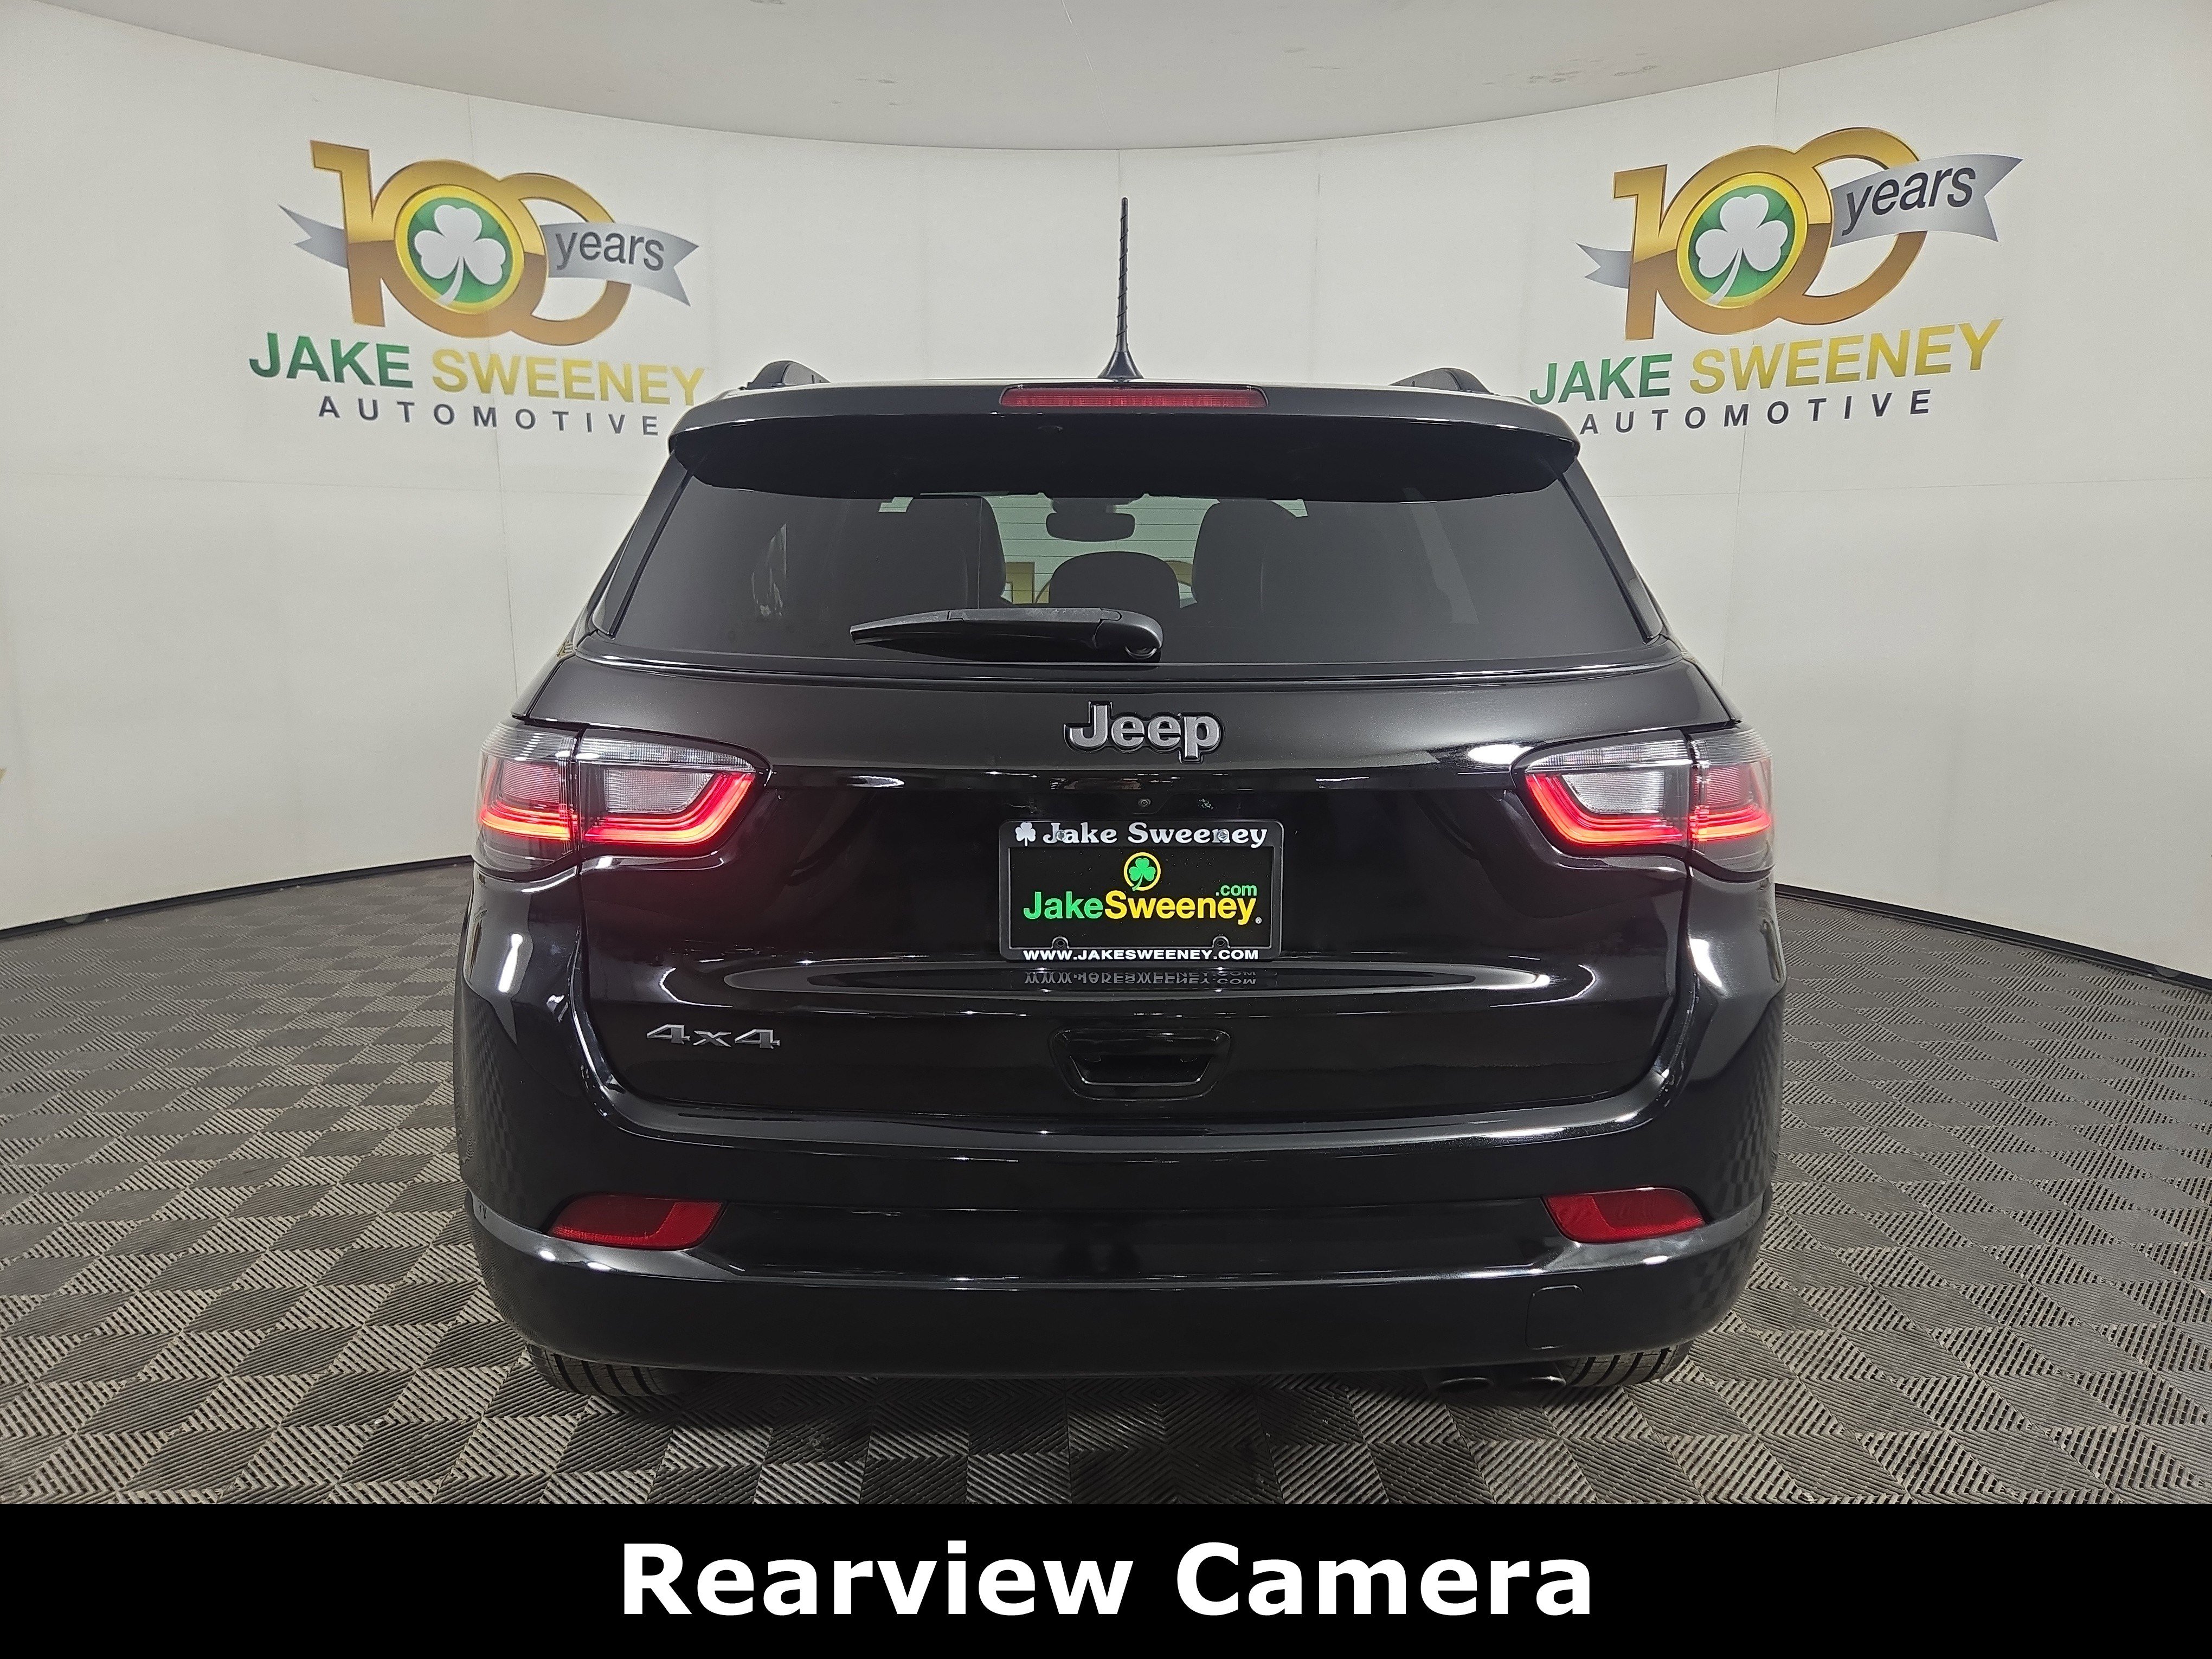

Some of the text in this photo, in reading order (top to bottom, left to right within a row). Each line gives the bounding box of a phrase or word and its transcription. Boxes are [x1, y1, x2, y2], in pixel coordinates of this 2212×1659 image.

[310, 139, 665, 346] 100 years
[1612, 126, 1977, 341] 100 years
[249, 332, 705, 406] JAKE SWEENEY
[1529, 318, 2004, 405] JAKE SWEENEY
[318, 395, 659, 436] AUTOMOTIVE
[1580, 389, 1931, 435] AUTOMOTIVE
[1065, 703, 1223, 762] Jeep
[1043, 822, 1117, 844] Jake
[1023, 949, 1259, 961] WWW.JAKESWEENEY.COM
[646, 1024, 780, 1049] 4x4
